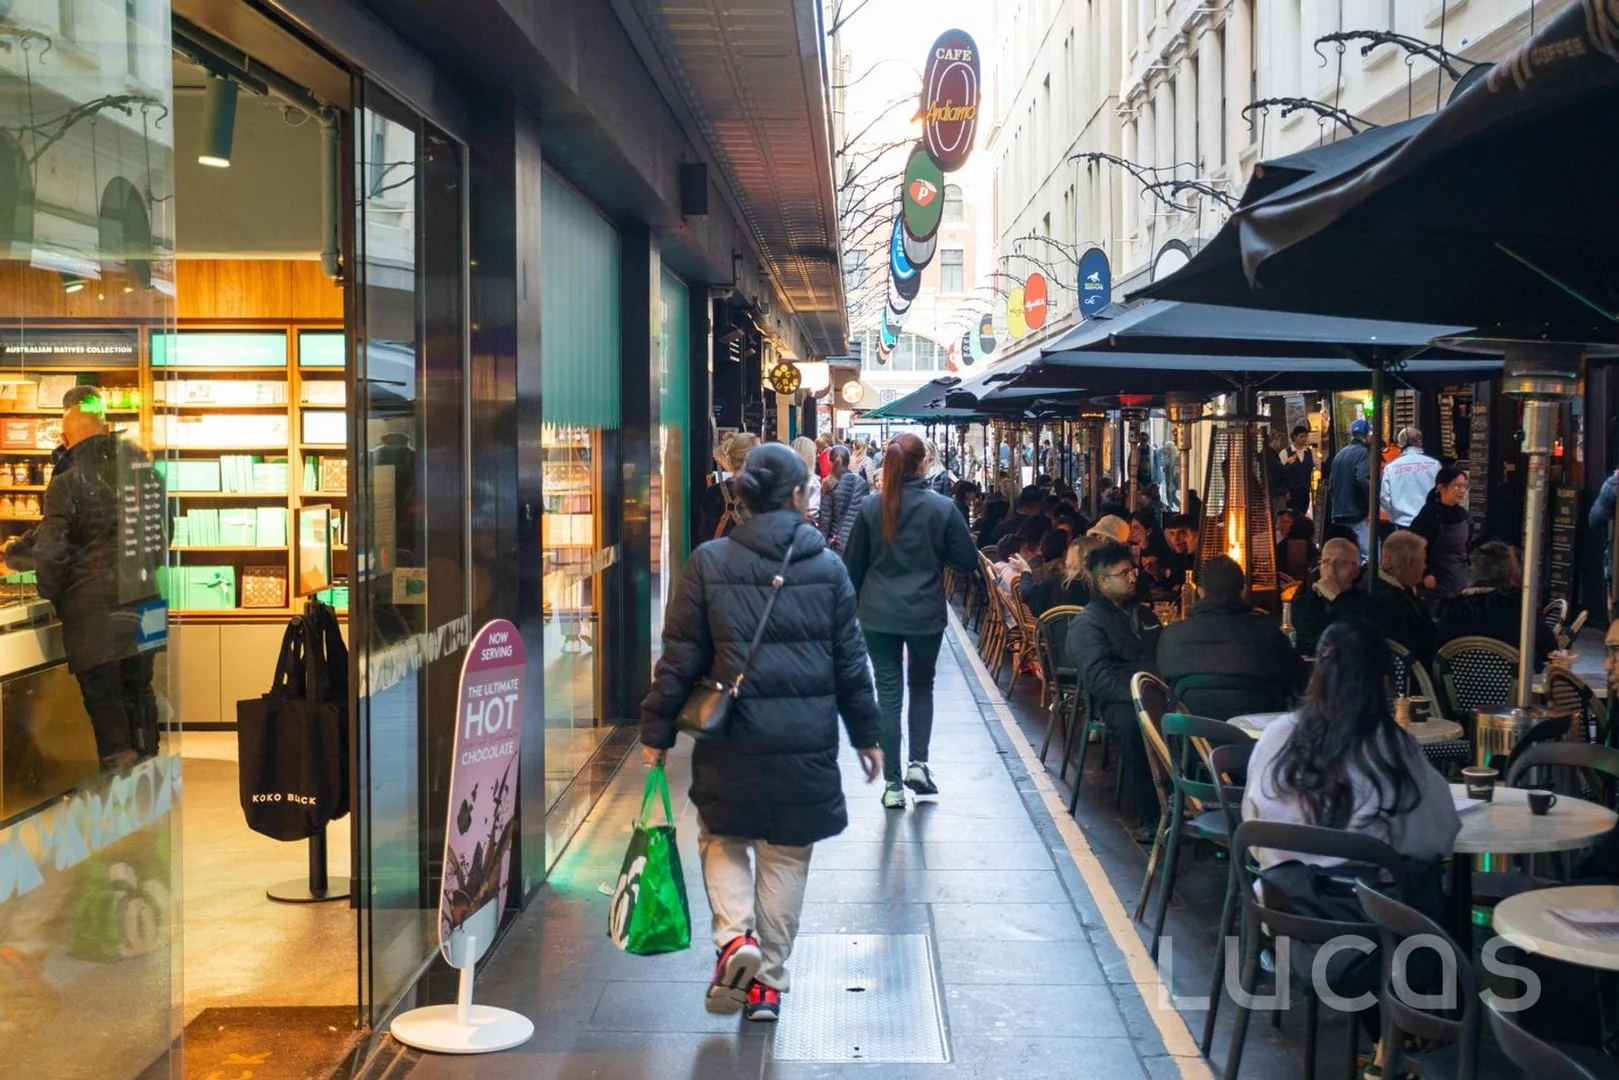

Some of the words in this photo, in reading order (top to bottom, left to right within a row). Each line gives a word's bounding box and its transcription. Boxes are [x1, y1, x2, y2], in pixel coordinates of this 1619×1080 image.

[935, 46, 972, 61] CAFÉ
[926, 99, 977, 127] Andiamo
[5, 346, 53, 354] AUSTRALIAN
[53, 346, 85, 354] NATIVES
[86, 346, 133, 354] COLLECTION
[488, 631, 509, 646] NOW
[480, 645, 513, 662] SERVING
[467, 684, 482, 699] THE
[484, 678, 519, 696] ULTIMATE
[464, 693, 519, 740] HOT
[461, 741, 514, 766] CHOCOLATE
[252, 793, 282, 803] KOKO
